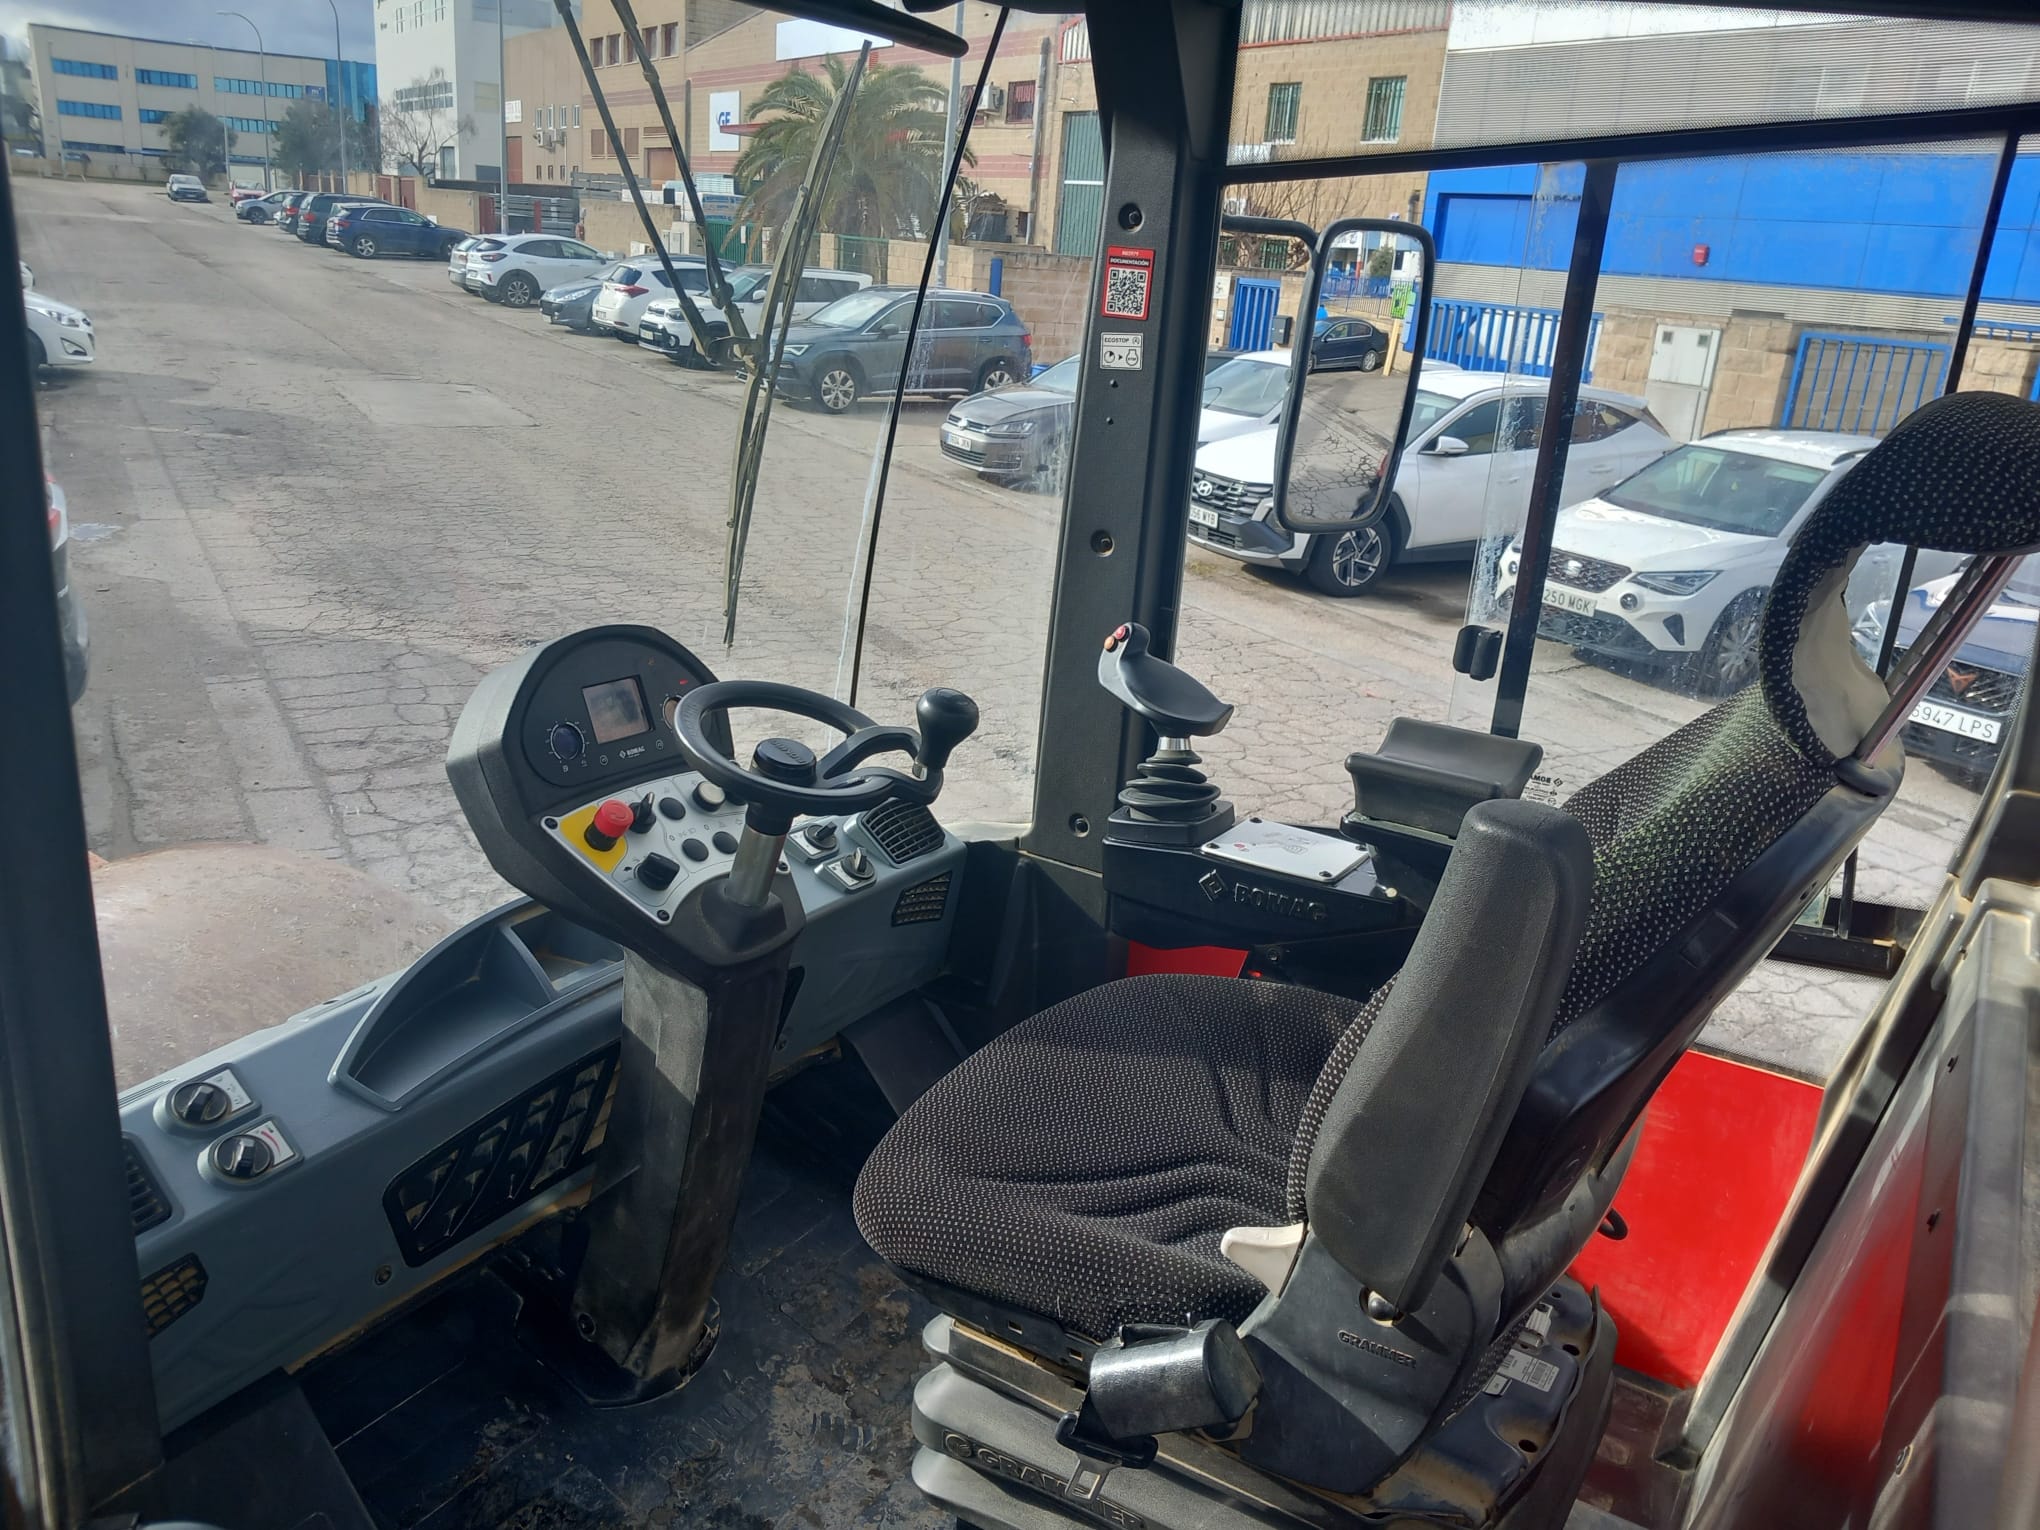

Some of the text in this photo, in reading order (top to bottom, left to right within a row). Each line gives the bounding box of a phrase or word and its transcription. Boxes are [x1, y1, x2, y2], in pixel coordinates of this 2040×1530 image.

[1110, 257, 1150, 267] DOCUMENTACIÓN
[1568, 594, 1591, 614] MGK
[1958, 717, 1994, 739] LPS
[1234, 882, 1329, 921] BOMAG
[1337, 1329, 1417, 1369] GRAMMER
[976, 1447, 1148, 1530] GRAMER
